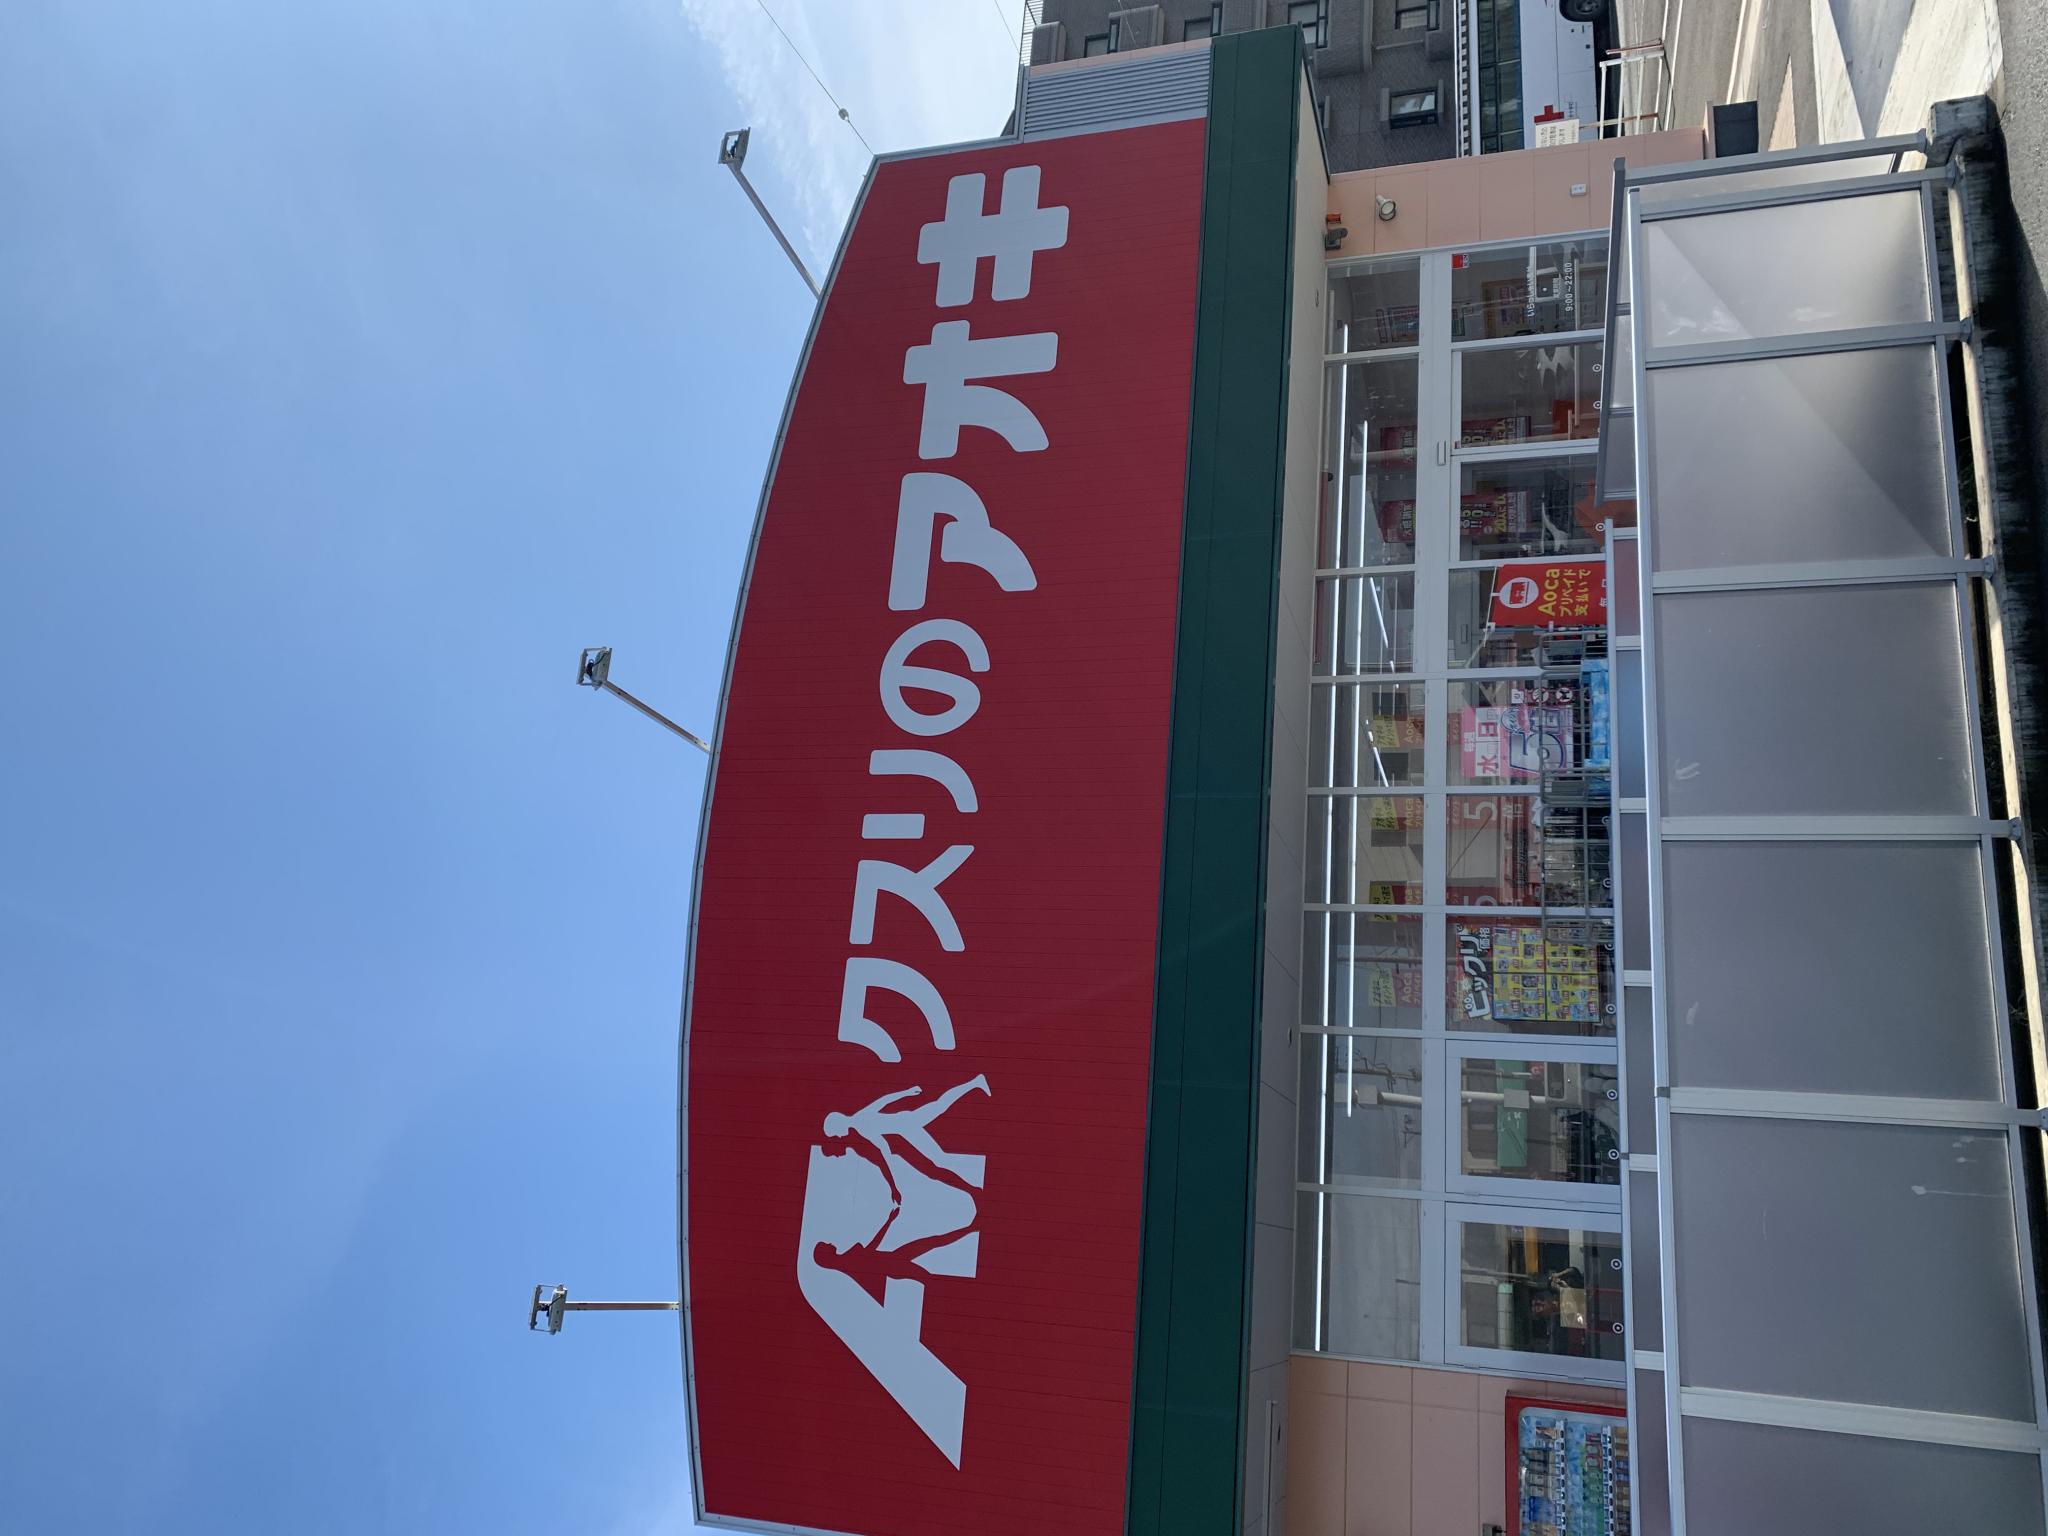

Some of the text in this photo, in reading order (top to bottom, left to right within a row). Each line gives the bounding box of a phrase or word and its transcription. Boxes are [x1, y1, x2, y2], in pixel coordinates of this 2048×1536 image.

[838, 165, 1069, 1062] クスリのアオキ
[1538, 568, 1560, 616] Aoca
[1559, 568, 1576, 617] プリペイド
[1574, 569, 1591, 616] 支払いで
[1463, 801, 1498, 821] 5
[1460, 936, 1491, 1017] ビックリ
